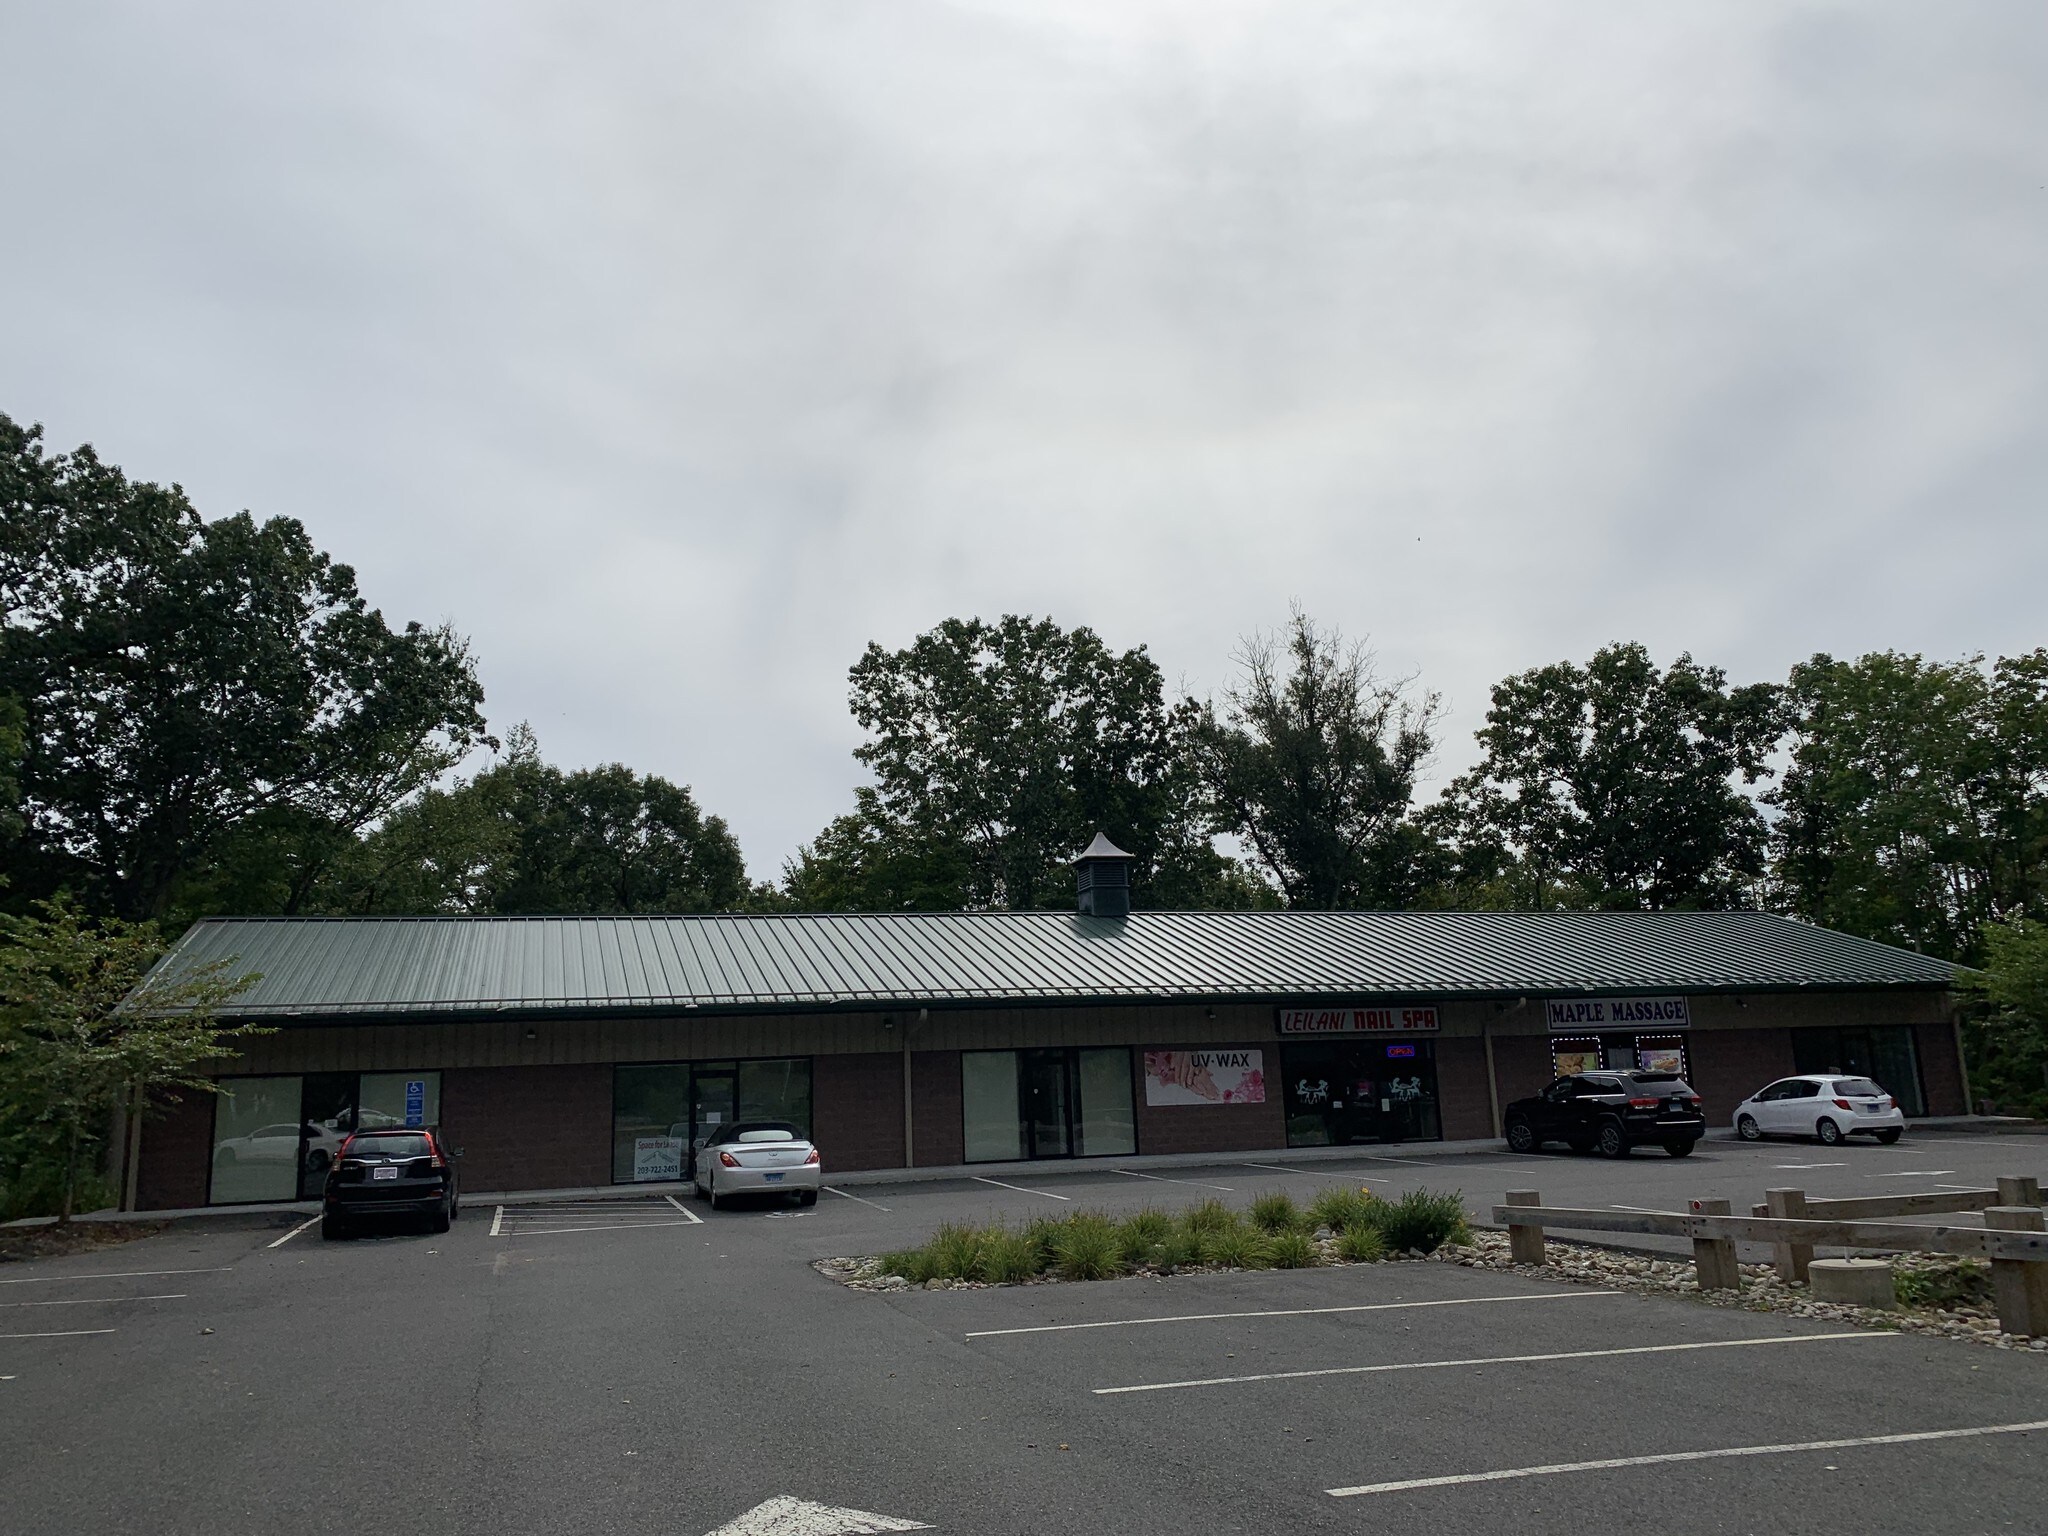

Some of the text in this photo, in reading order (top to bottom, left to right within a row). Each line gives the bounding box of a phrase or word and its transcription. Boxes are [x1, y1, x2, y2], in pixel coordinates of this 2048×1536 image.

[1551, 1001, 1685, 1023] MAPLE MASSAGE
[1285, 1010, 1436, 1031] LEILANI NAIL SPA
[1389, 1047, 1412, 1056] OPEN
[638, 1140, 655, 1151] Space
[655, 1140, 663, 1149] for
[637, 1165, 678, 1175] 203-722-2451
